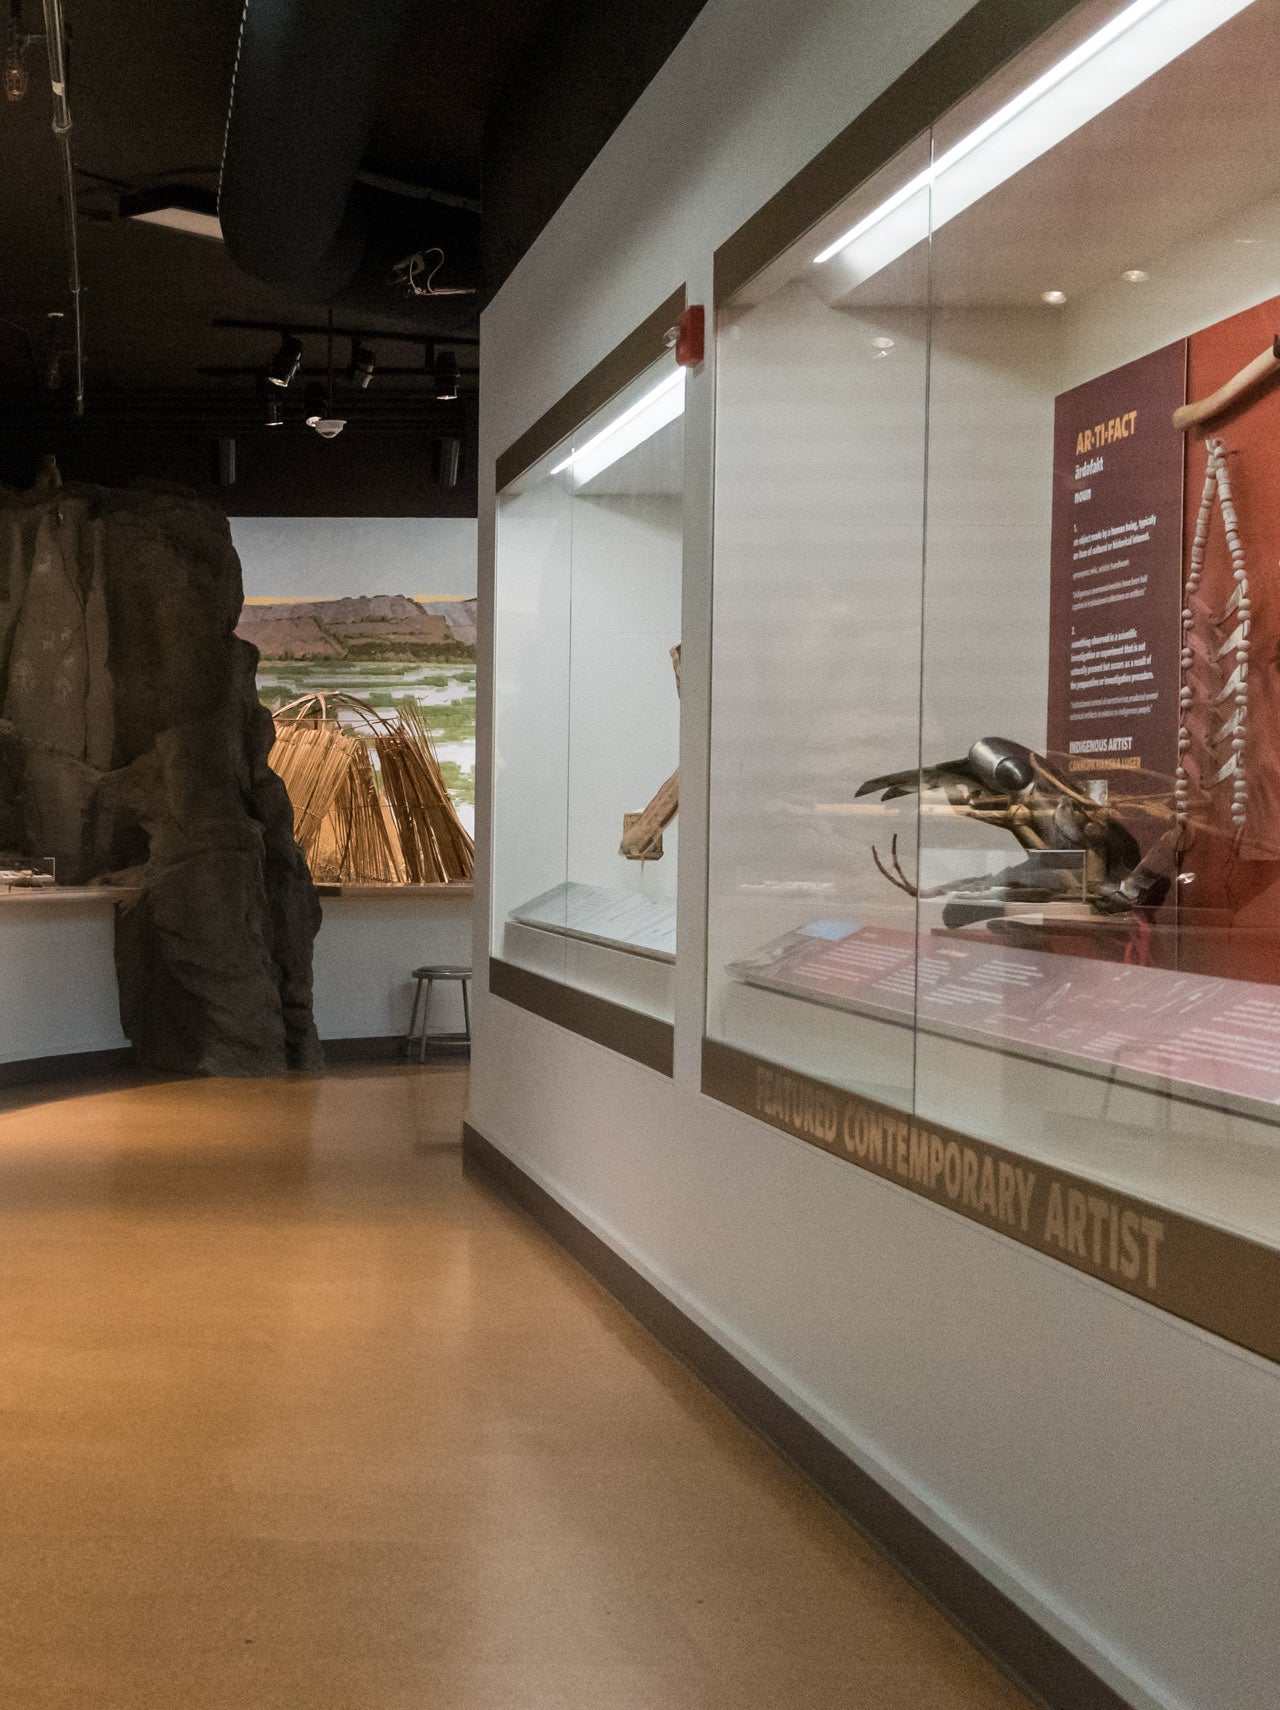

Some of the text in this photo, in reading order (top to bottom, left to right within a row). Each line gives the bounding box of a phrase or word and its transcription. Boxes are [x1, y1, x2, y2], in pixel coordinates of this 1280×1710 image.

[1069, 736, 1133, 754] INDIGENOUS ARTIST
[843, 1105, 1036, 1232] CONTEMPORARY
[1044, 1181, 1164, 1289] ARTIST
